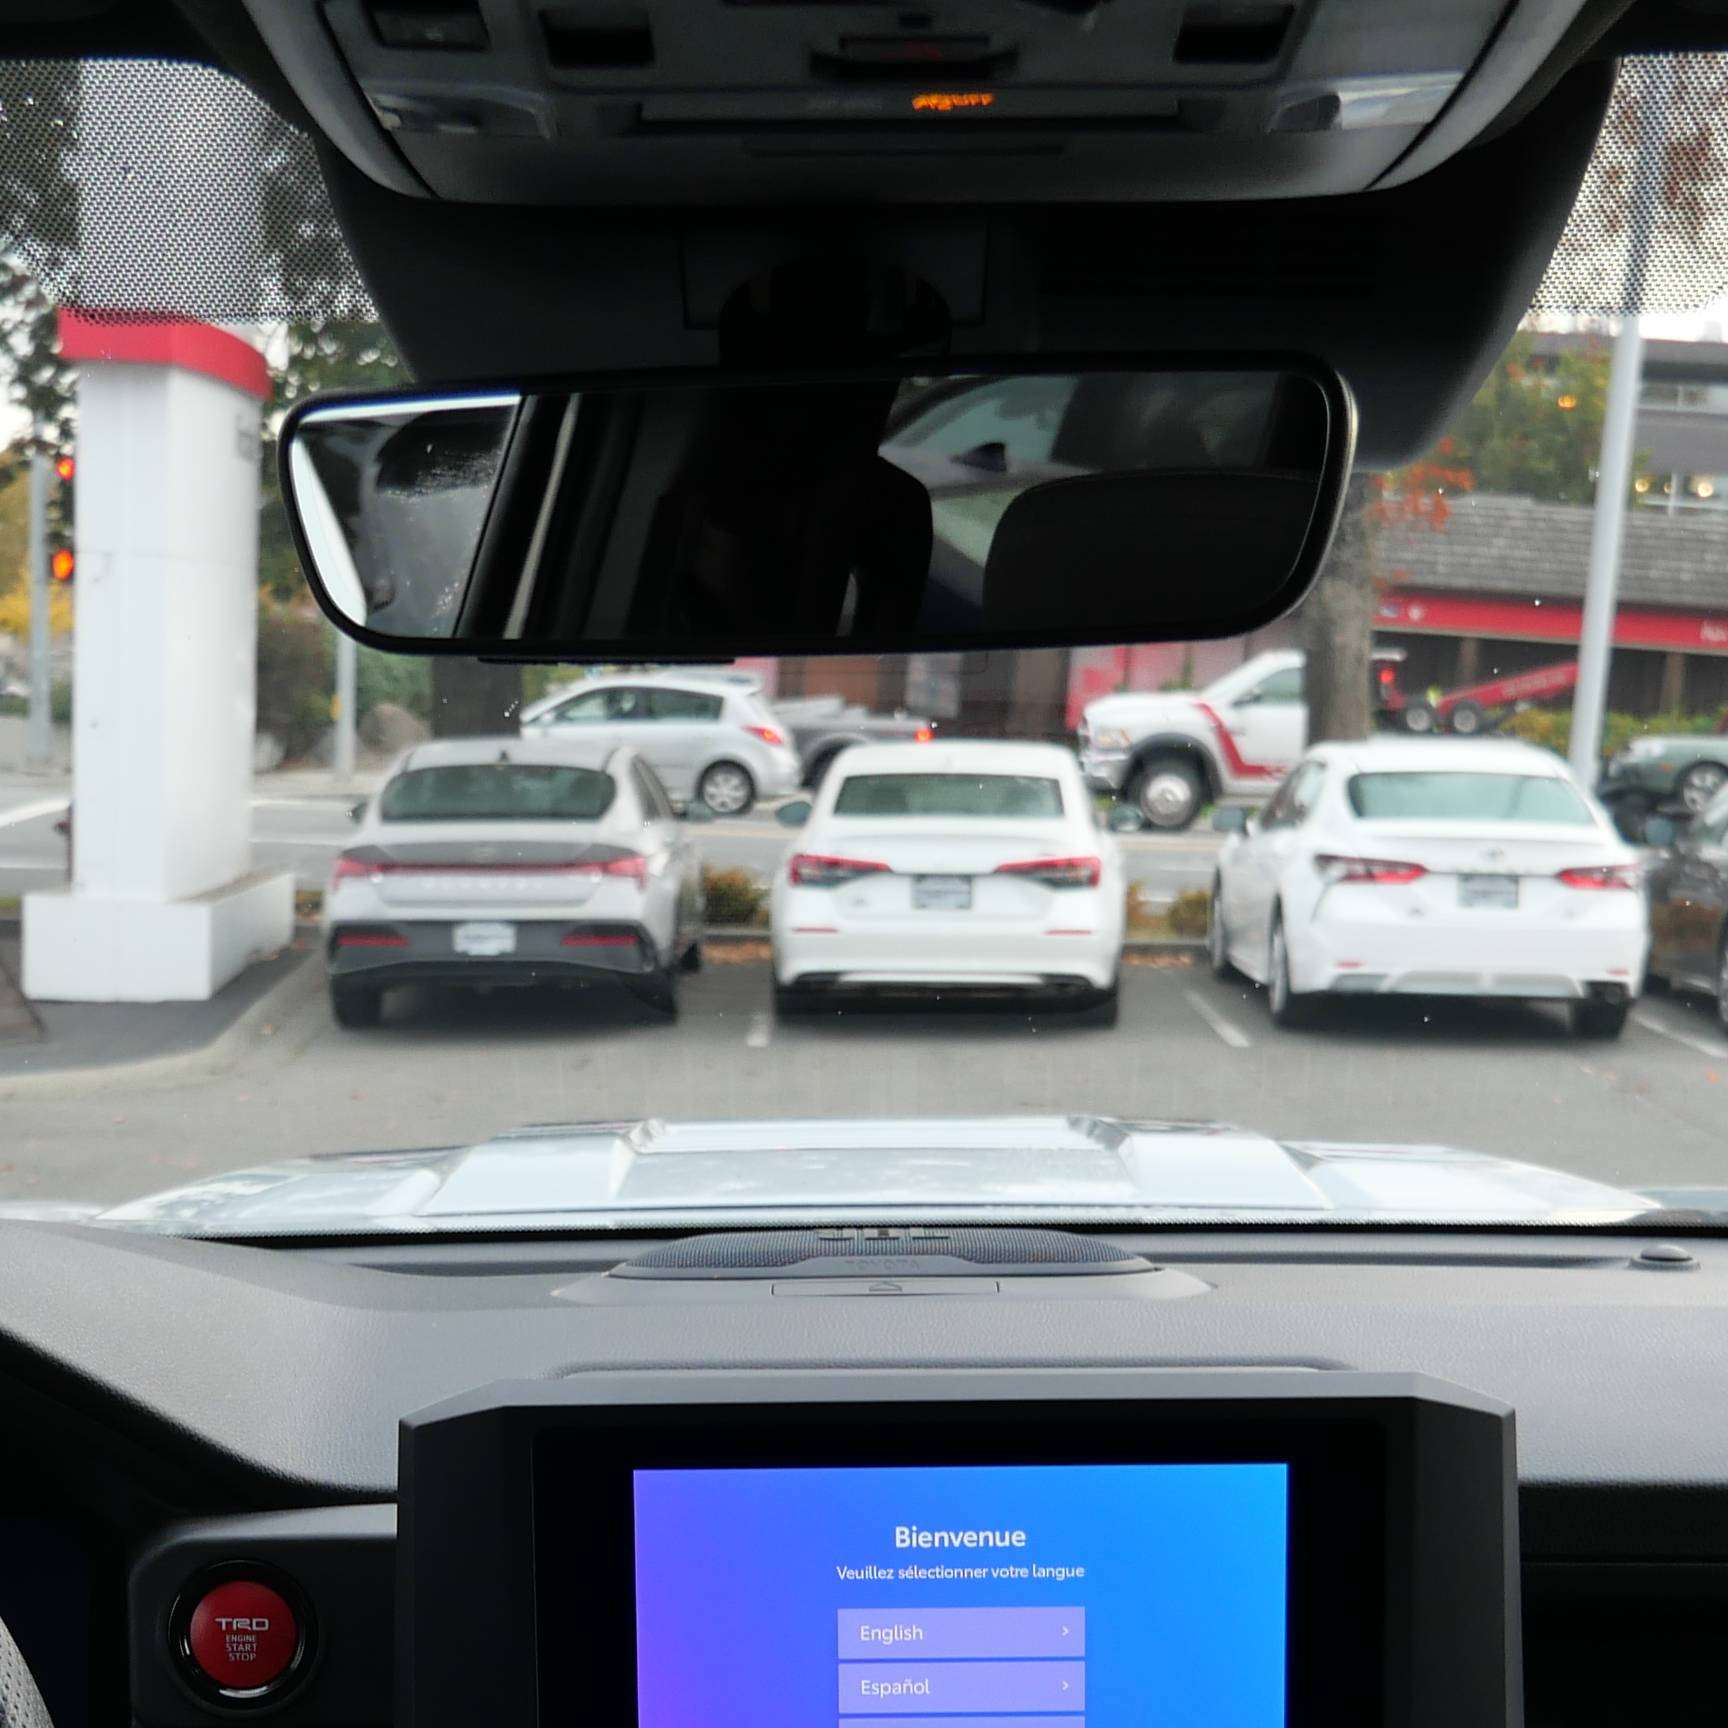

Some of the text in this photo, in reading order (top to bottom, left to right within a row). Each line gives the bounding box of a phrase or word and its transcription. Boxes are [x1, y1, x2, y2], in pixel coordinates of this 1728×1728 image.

[894, 1525, 1027, 1549] Bienvenue
[836, 1564, 1085, 1581] Veuillez sélectionner votre langue
[214, 1617, 270, 1632] TRD
[225, 1634, 258, 1643] ENGINE
[860, 1624, 924, 1646] English
[225, 1643, 258, 1652] START
[228, 1652, 257, 1661] STOP
[860, 1678, 931, 1699] Español
